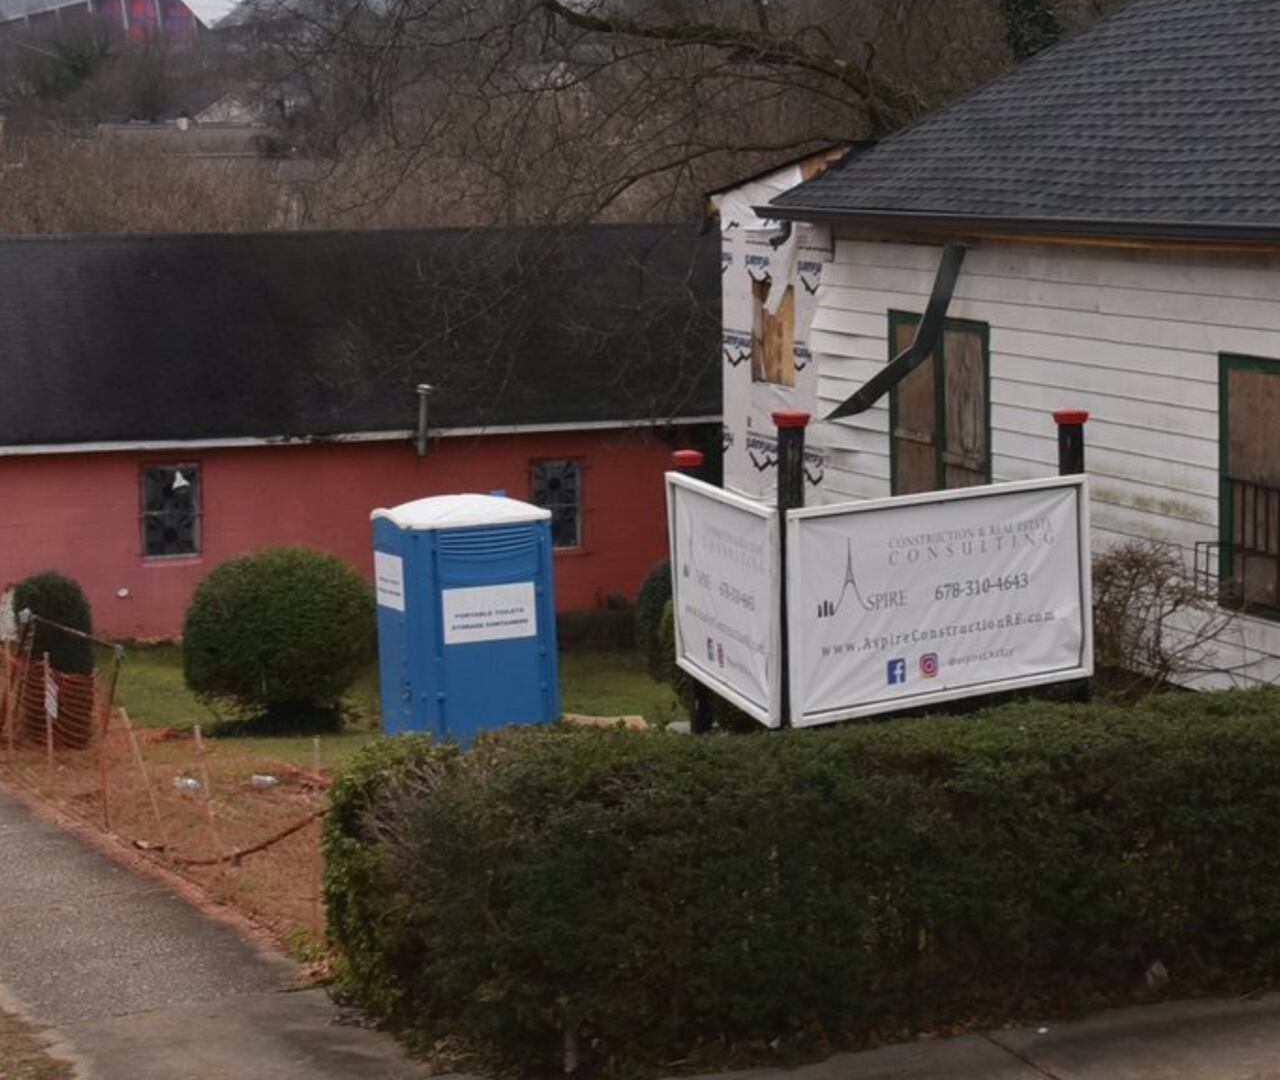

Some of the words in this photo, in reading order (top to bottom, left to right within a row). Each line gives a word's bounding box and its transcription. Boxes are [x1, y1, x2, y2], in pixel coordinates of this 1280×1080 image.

[888, 529, 975, 550] CONSTRUCTION
[990, 524, 1013, 536] REAL
[888, 532, 1055, 566] CONSULTING
[934, 573, 1030, 601] 678-310-4643
